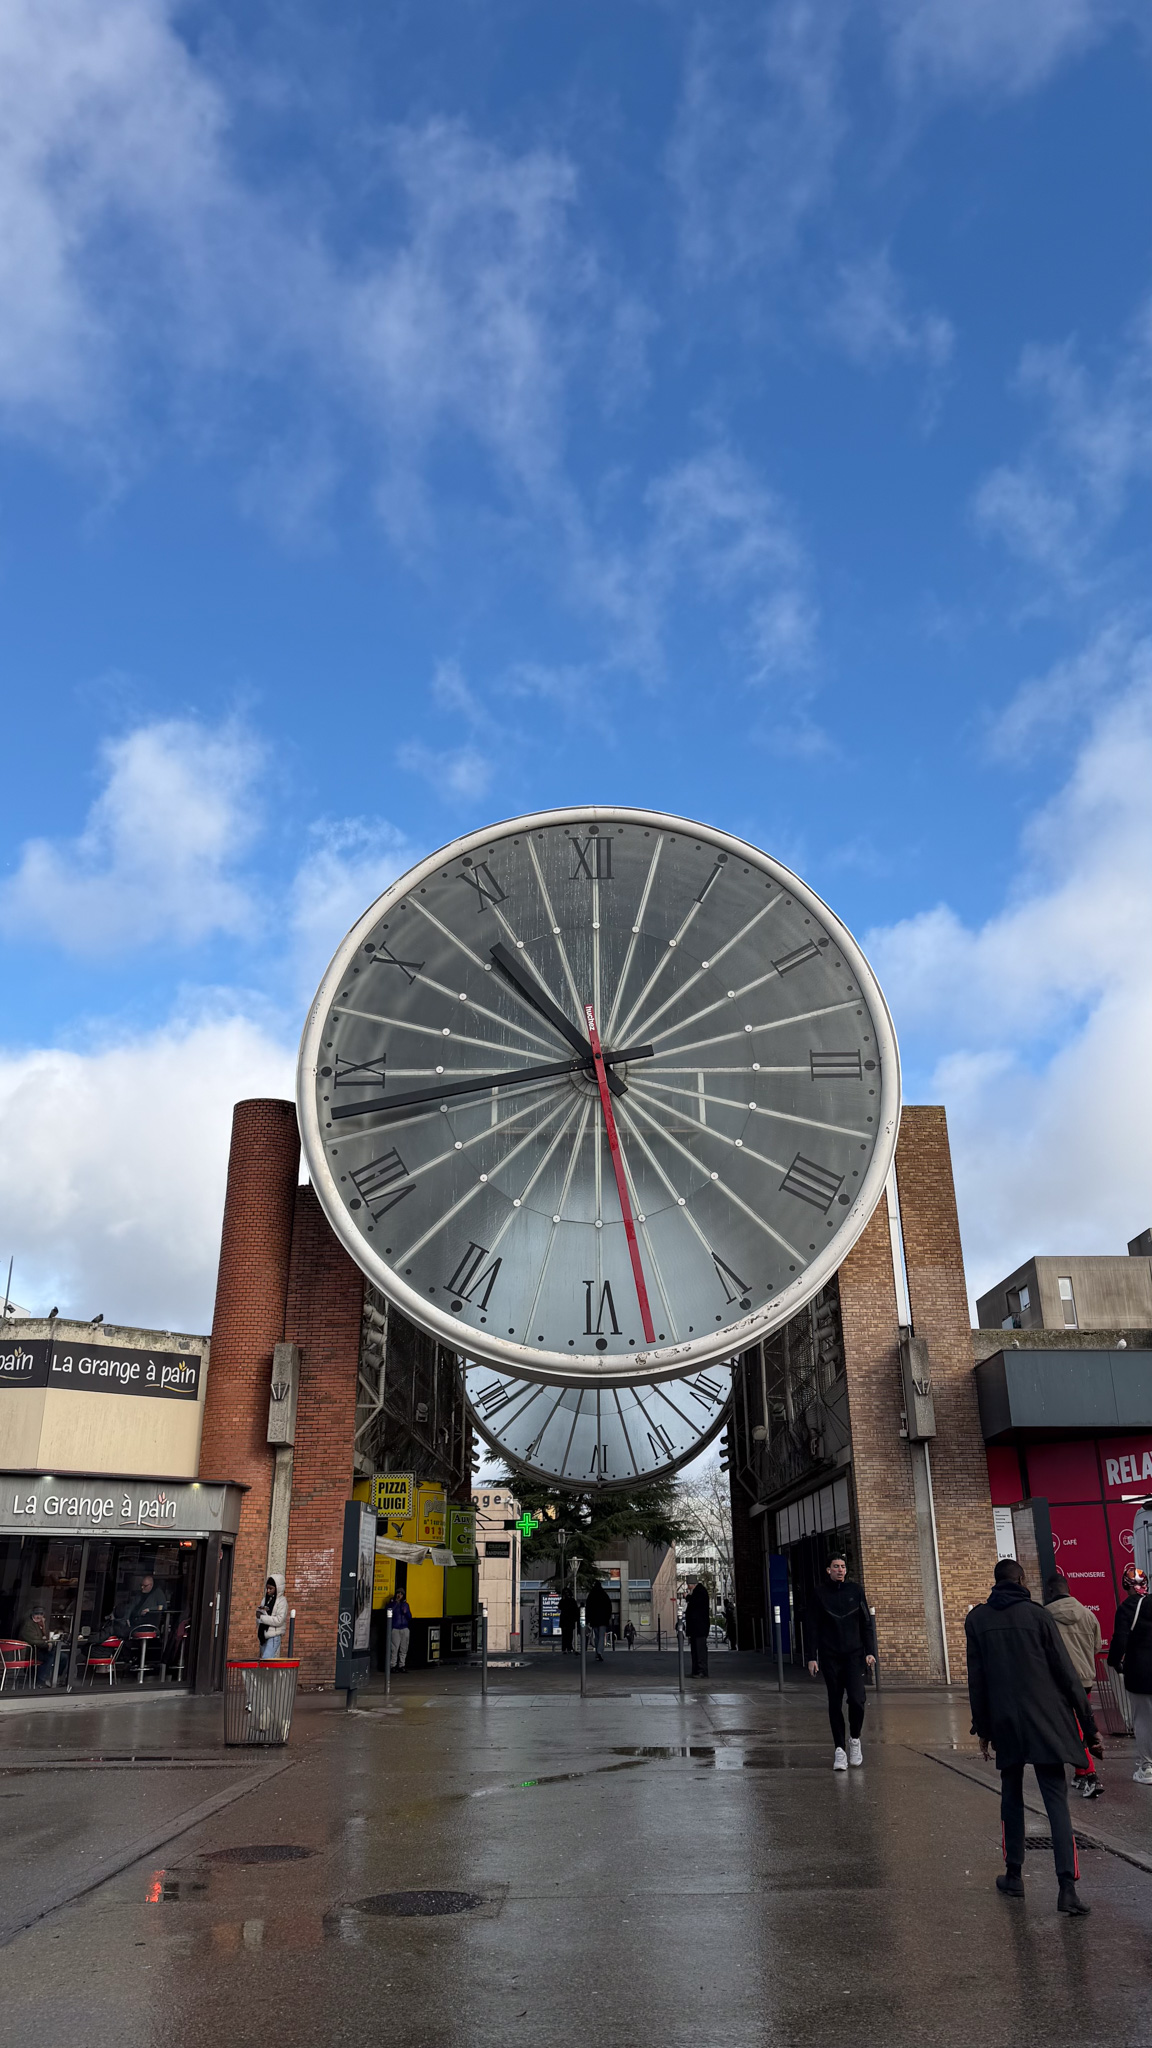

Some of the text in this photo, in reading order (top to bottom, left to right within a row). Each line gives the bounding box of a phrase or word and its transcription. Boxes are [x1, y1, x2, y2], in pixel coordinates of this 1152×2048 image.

[569, 836, 615, 880] XII
[456, 861, 509, 913] XI
[369, 941, 426, 985] X
[770, 938, 823, 978] II
[585, 1006, 595, 1031] huchez
[334, 1053, 386, 1089] IX
[809, 1049, 863, 1082] III
[348, 1146, 417, 1223] VIII
[778, 1152, 846, 1215] IIII
[443, 1241, 503, 1312] VII
[711, 1251, 753, 1305] V
[582, 1280, 623, 1335] VI
[52, 1354, 196, 1388] La Grange à pain
[1105, 1450, 1152, 1486] RELA
[378, 1482, 407, 1495] PIZZA
[378, 1497, 406, 1510] LUIGI
[13, 1493, 177, 1526] La Grange à pain
[1062, 1538, 1078, 1546] CAFÉ
